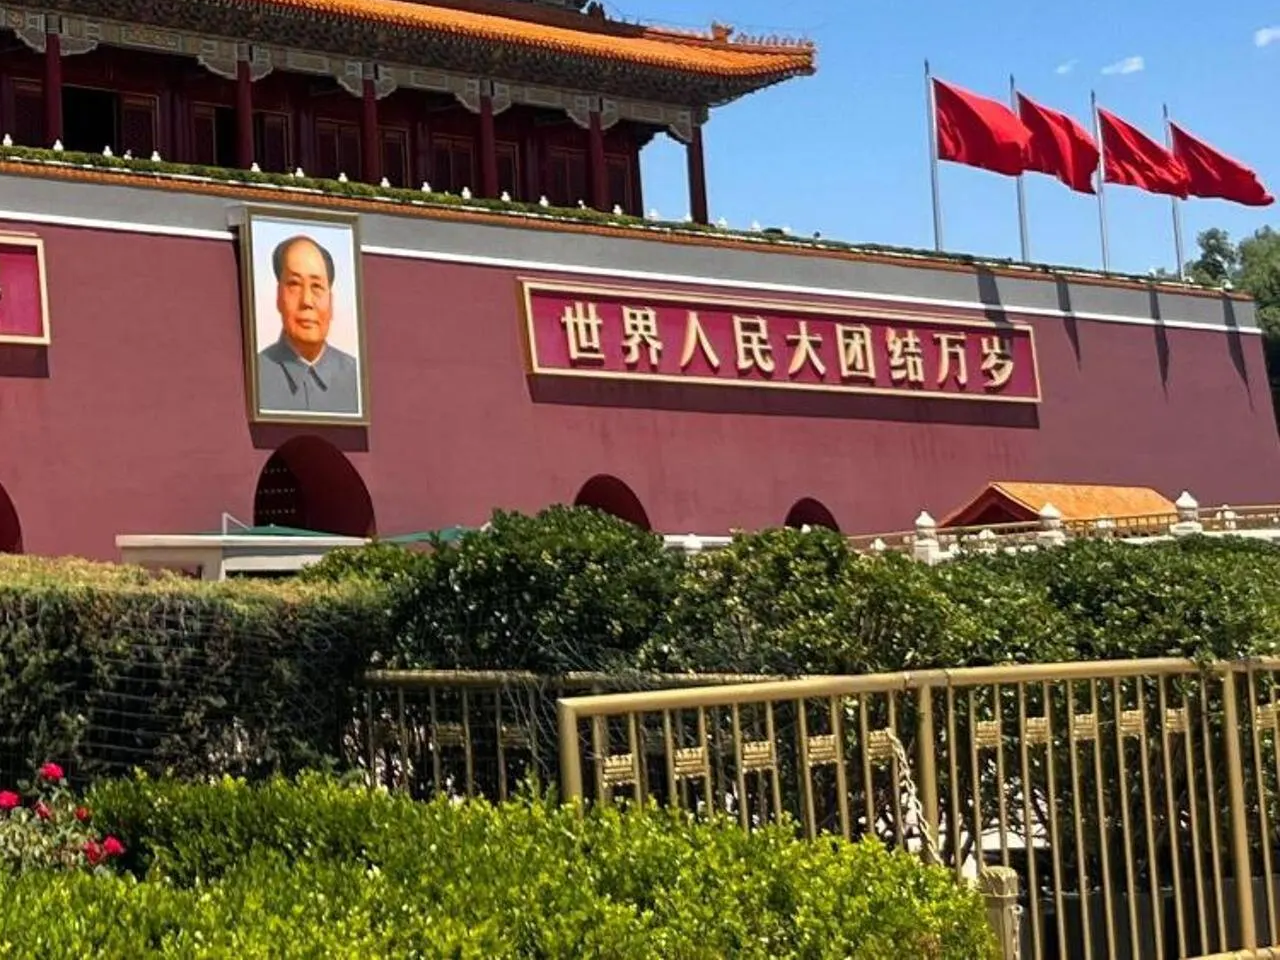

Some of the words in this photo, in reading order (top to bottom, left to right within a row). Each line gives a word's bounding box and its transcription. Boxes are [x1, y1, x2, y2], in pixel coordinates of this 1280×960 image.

[560, 300, 1015, 390] 世界人民大团结万岁
